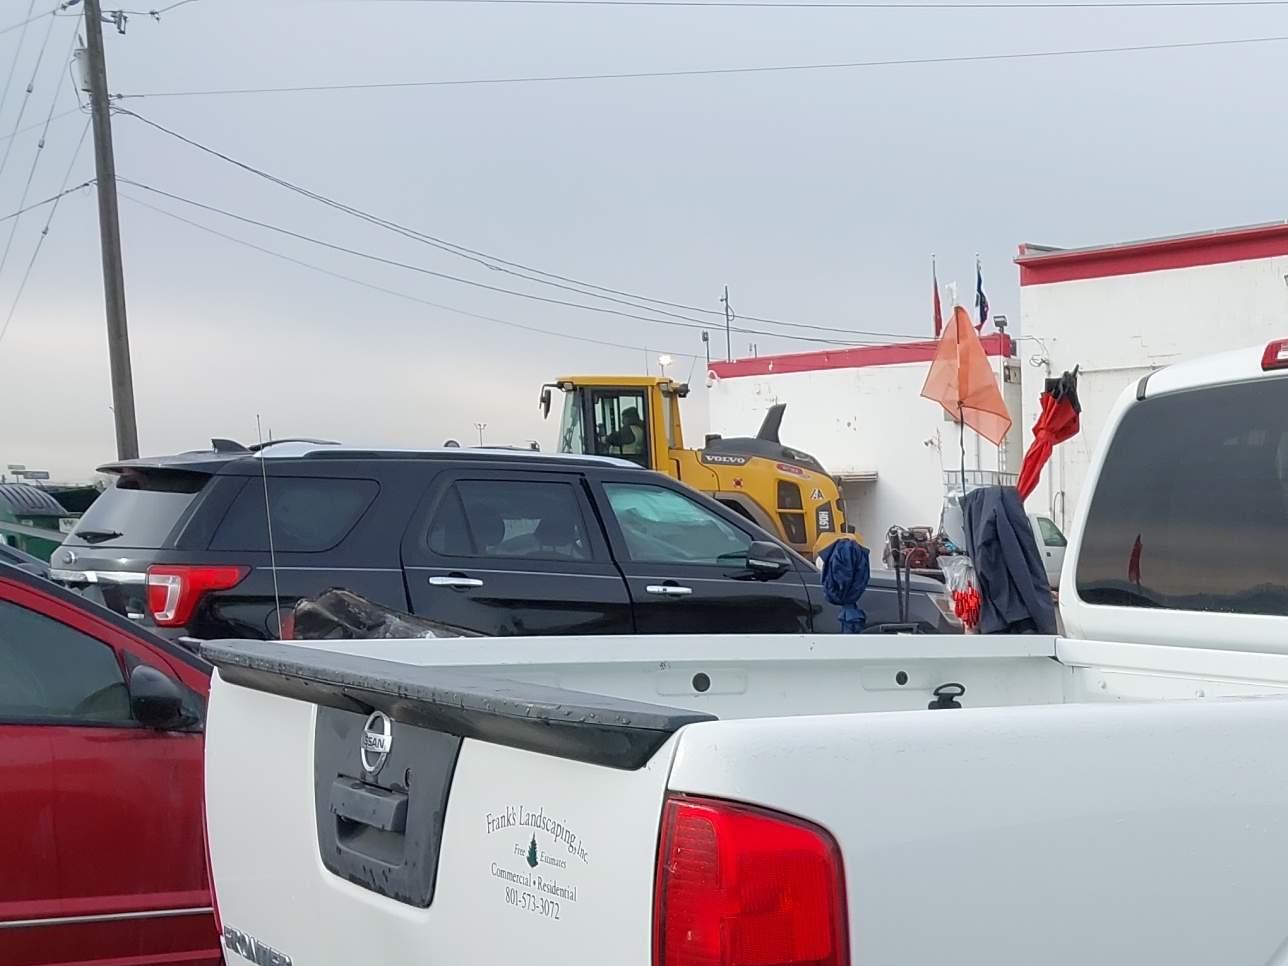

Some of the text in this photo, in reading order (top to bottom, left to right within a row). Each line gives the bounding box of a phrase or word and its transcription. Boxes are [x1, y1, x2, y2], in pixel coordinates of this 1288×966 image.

[704, 455, 745, 464] VOLVO
[486, 805, 516, 834] Frank's
[491, 862, 532, 888] Commercial
[537, 876, 577, 902] Residential
[505, 886, 560, 920] 801-573-3072
